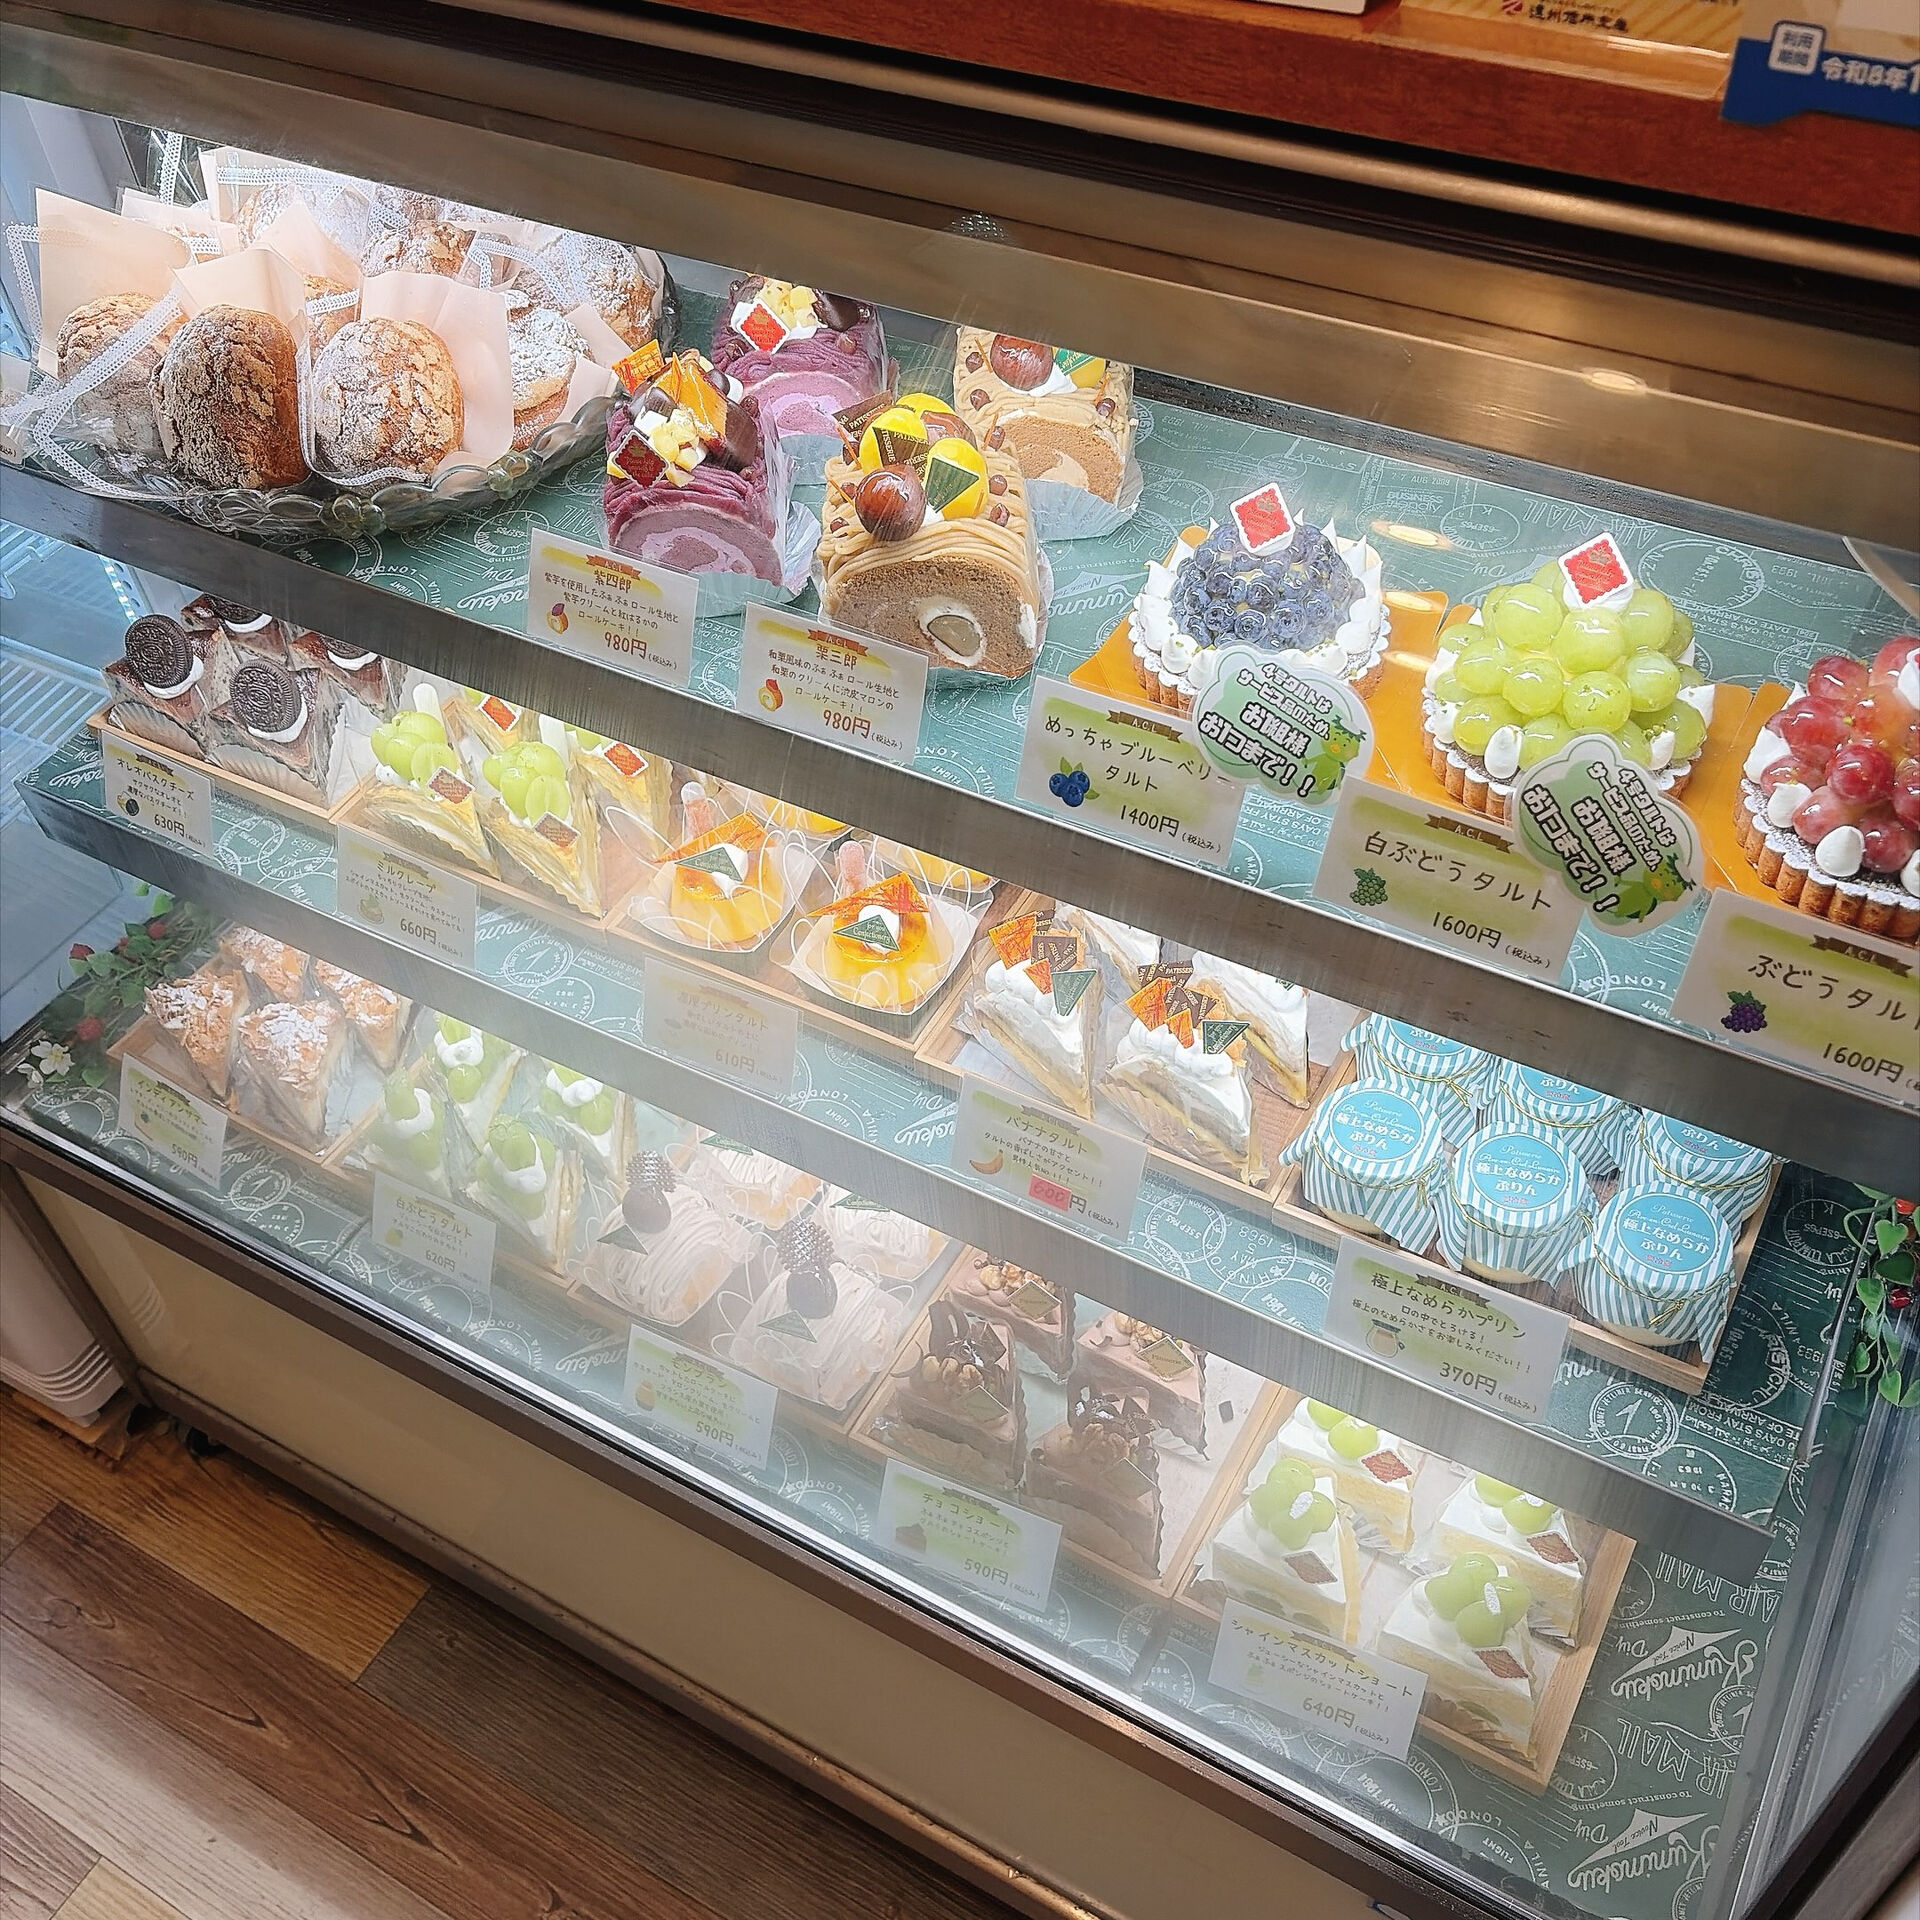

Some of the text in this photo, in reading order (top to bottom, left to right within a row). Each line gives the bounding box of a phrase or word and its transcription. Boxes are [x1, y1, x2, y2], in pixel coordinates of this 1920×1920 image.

[594, 569, 632, 594] 紫四郎
[604, 631, 647, 660] 980円
[816, 644, 857, 670] 栗三郎
[1262, 663, 1333, 714] 4号タルトは
[823, 710, 871, 738] 980円
[1045, 715, 1232, 783] めっちゃブルーベリー
[117, 758, 194, 800] オレオバスクチーズ
[1106, 765, 1159, 792] タルト
[154, 814, 185, 837] 630円
[1120, 805, 1222, 852] 1400円 (税込み)
[377, 861, 436, 893] ミルクレープ
[1364, 830, 1552, 911] 白ぶどうタルト
[400, 919, 436, 945] 660円
[1433, 911, 1550, 968] 1600円 (税込み)
[1823, 1043, 1904, 1083] 1600円
[1540, 1076, 1580, 1095] ぷりん
[1007, 1115, 1087, 1156] バナナタルト
[1335, 1111, 1415, 1145] 極上なめらか
[1349, 1130, 1387, 1150] ぷりん
[1681, 1126, 1720, 1151] ぷりん
[1476, 1161, 1562, 1186] 極上なめらか
[1495, 1180, 1537, 1197] ぷりん
[396, 1197, 472, 1238] 白ぶどうタルト
[1623, 1217, 1710, 1254] 極上なめらか
[1641, 1238, 1683, 1261] ぷりん
[1371, 1272, 1526, 1339] 極上なめらかプリン
[672, 1357, 728, 1388] モンブラン
[1440, 1361, 1497, 1396] 370円
[696, 1421, 734, 1447] 590円
[923, 1492, 1015, 1536] チョコショート
[964, 1558, 1009, 1586] 590円
[1231, 1617, 1413, 1698] シャインマスカットショート
[1614, 1636, 1649, 1658] Diy
[1303, 1698, 1356, 1729] 640円
[1572, 1818, 1608, 1844] Diy
